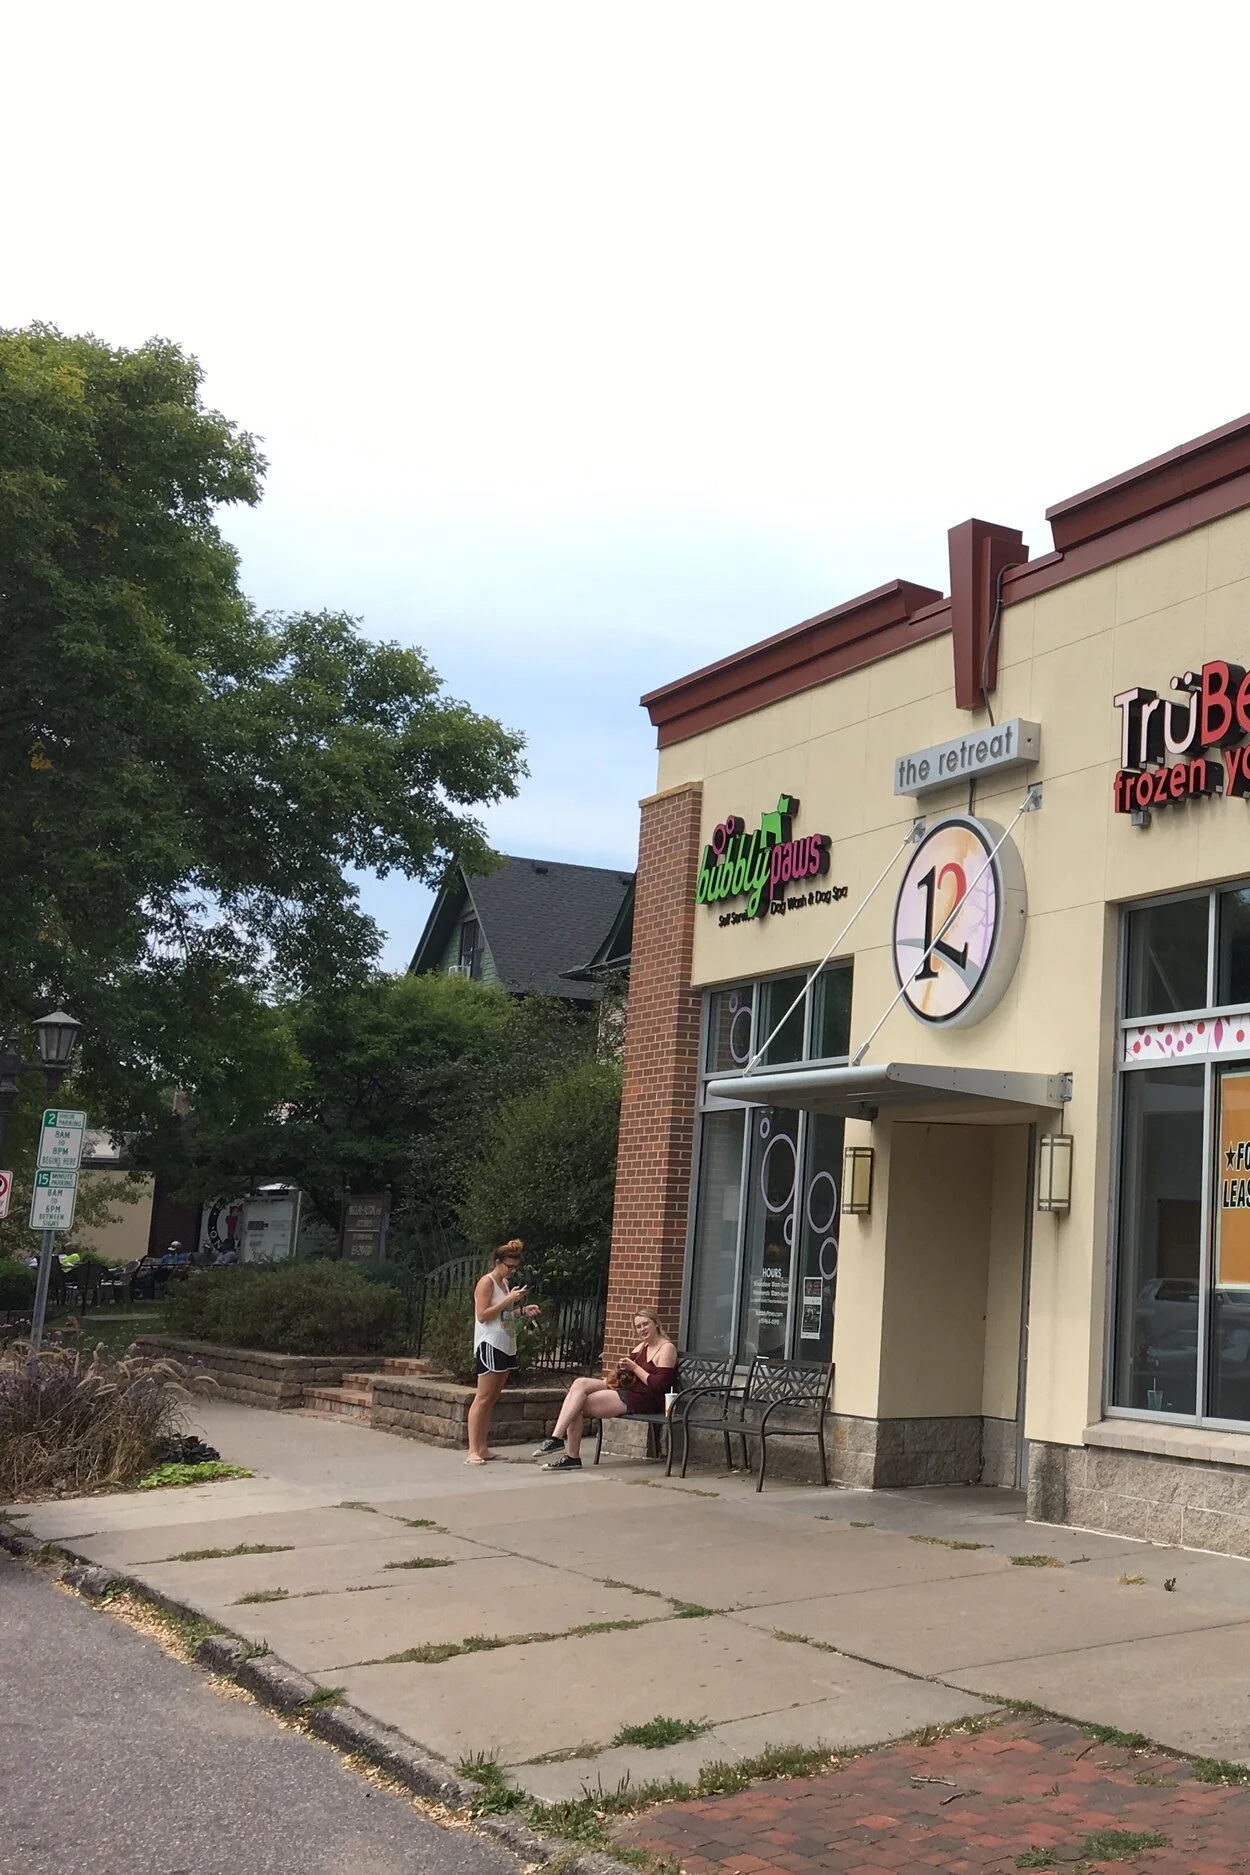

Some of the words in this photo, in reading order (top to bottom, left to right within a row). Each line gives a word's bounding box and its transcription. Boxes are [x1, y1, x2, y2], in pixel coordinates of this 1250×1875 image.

[898, 759, 931, 788] the
[938, 725, 1013, 776] retreat
[1113, 757, 1207, 813] frozen
[696, 829, 770, 917] bubbly
[770, 833, 824, 900] paws
[718, 913, 730, 928] Self
[770, 901, 786, 915] Dog
[787, 895, 807, 910] Wash
[815, 889, 831, 905] Dog
[832, 886, 848, 901] Spa
[914, 862, 969, 981] 12
[48, 1113, 56, 1125] 2
[55, 1130, 70, 1138] 8AM
[38, 1173, 49, 1185] 15
[47, 1189, 63, 1197] 8AM
[45, 1205, 61, 1213] 6PM
[762, 1268, 782, 1278] HOURS
